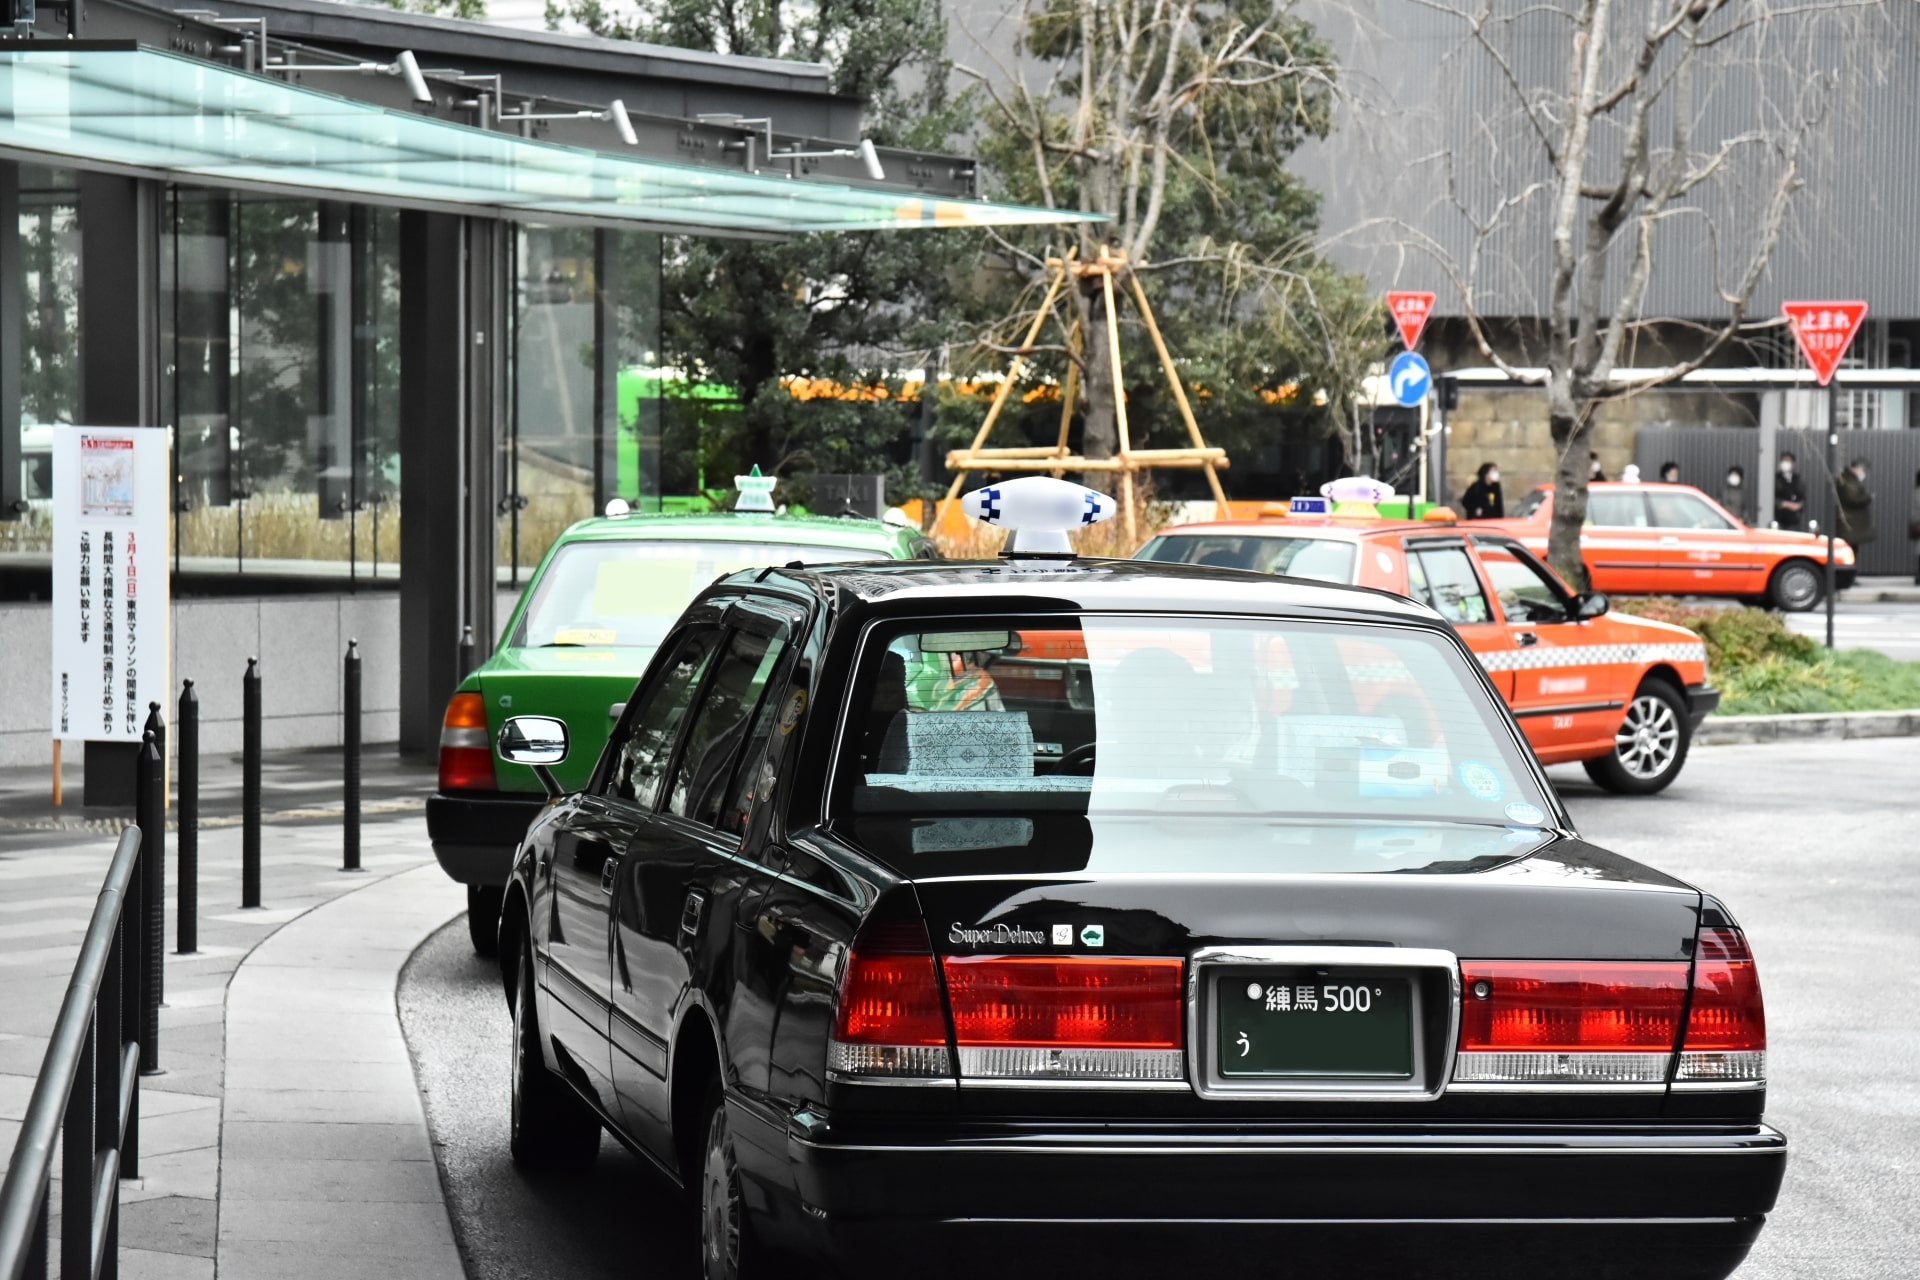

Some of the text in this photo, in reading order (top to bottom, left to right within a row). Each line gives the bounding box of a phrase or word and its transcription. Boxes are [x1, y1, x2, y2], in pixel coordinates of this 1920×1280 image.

[1800, 310, 1851, 330] 止まれ
[1807, 333, 1844, 350] STOP
[949, 922, 1045, 949] Super Deluxe
[1265, 985, 1371, 1012] 練馬 500
[1236, 1031, 1250, 1057] う
